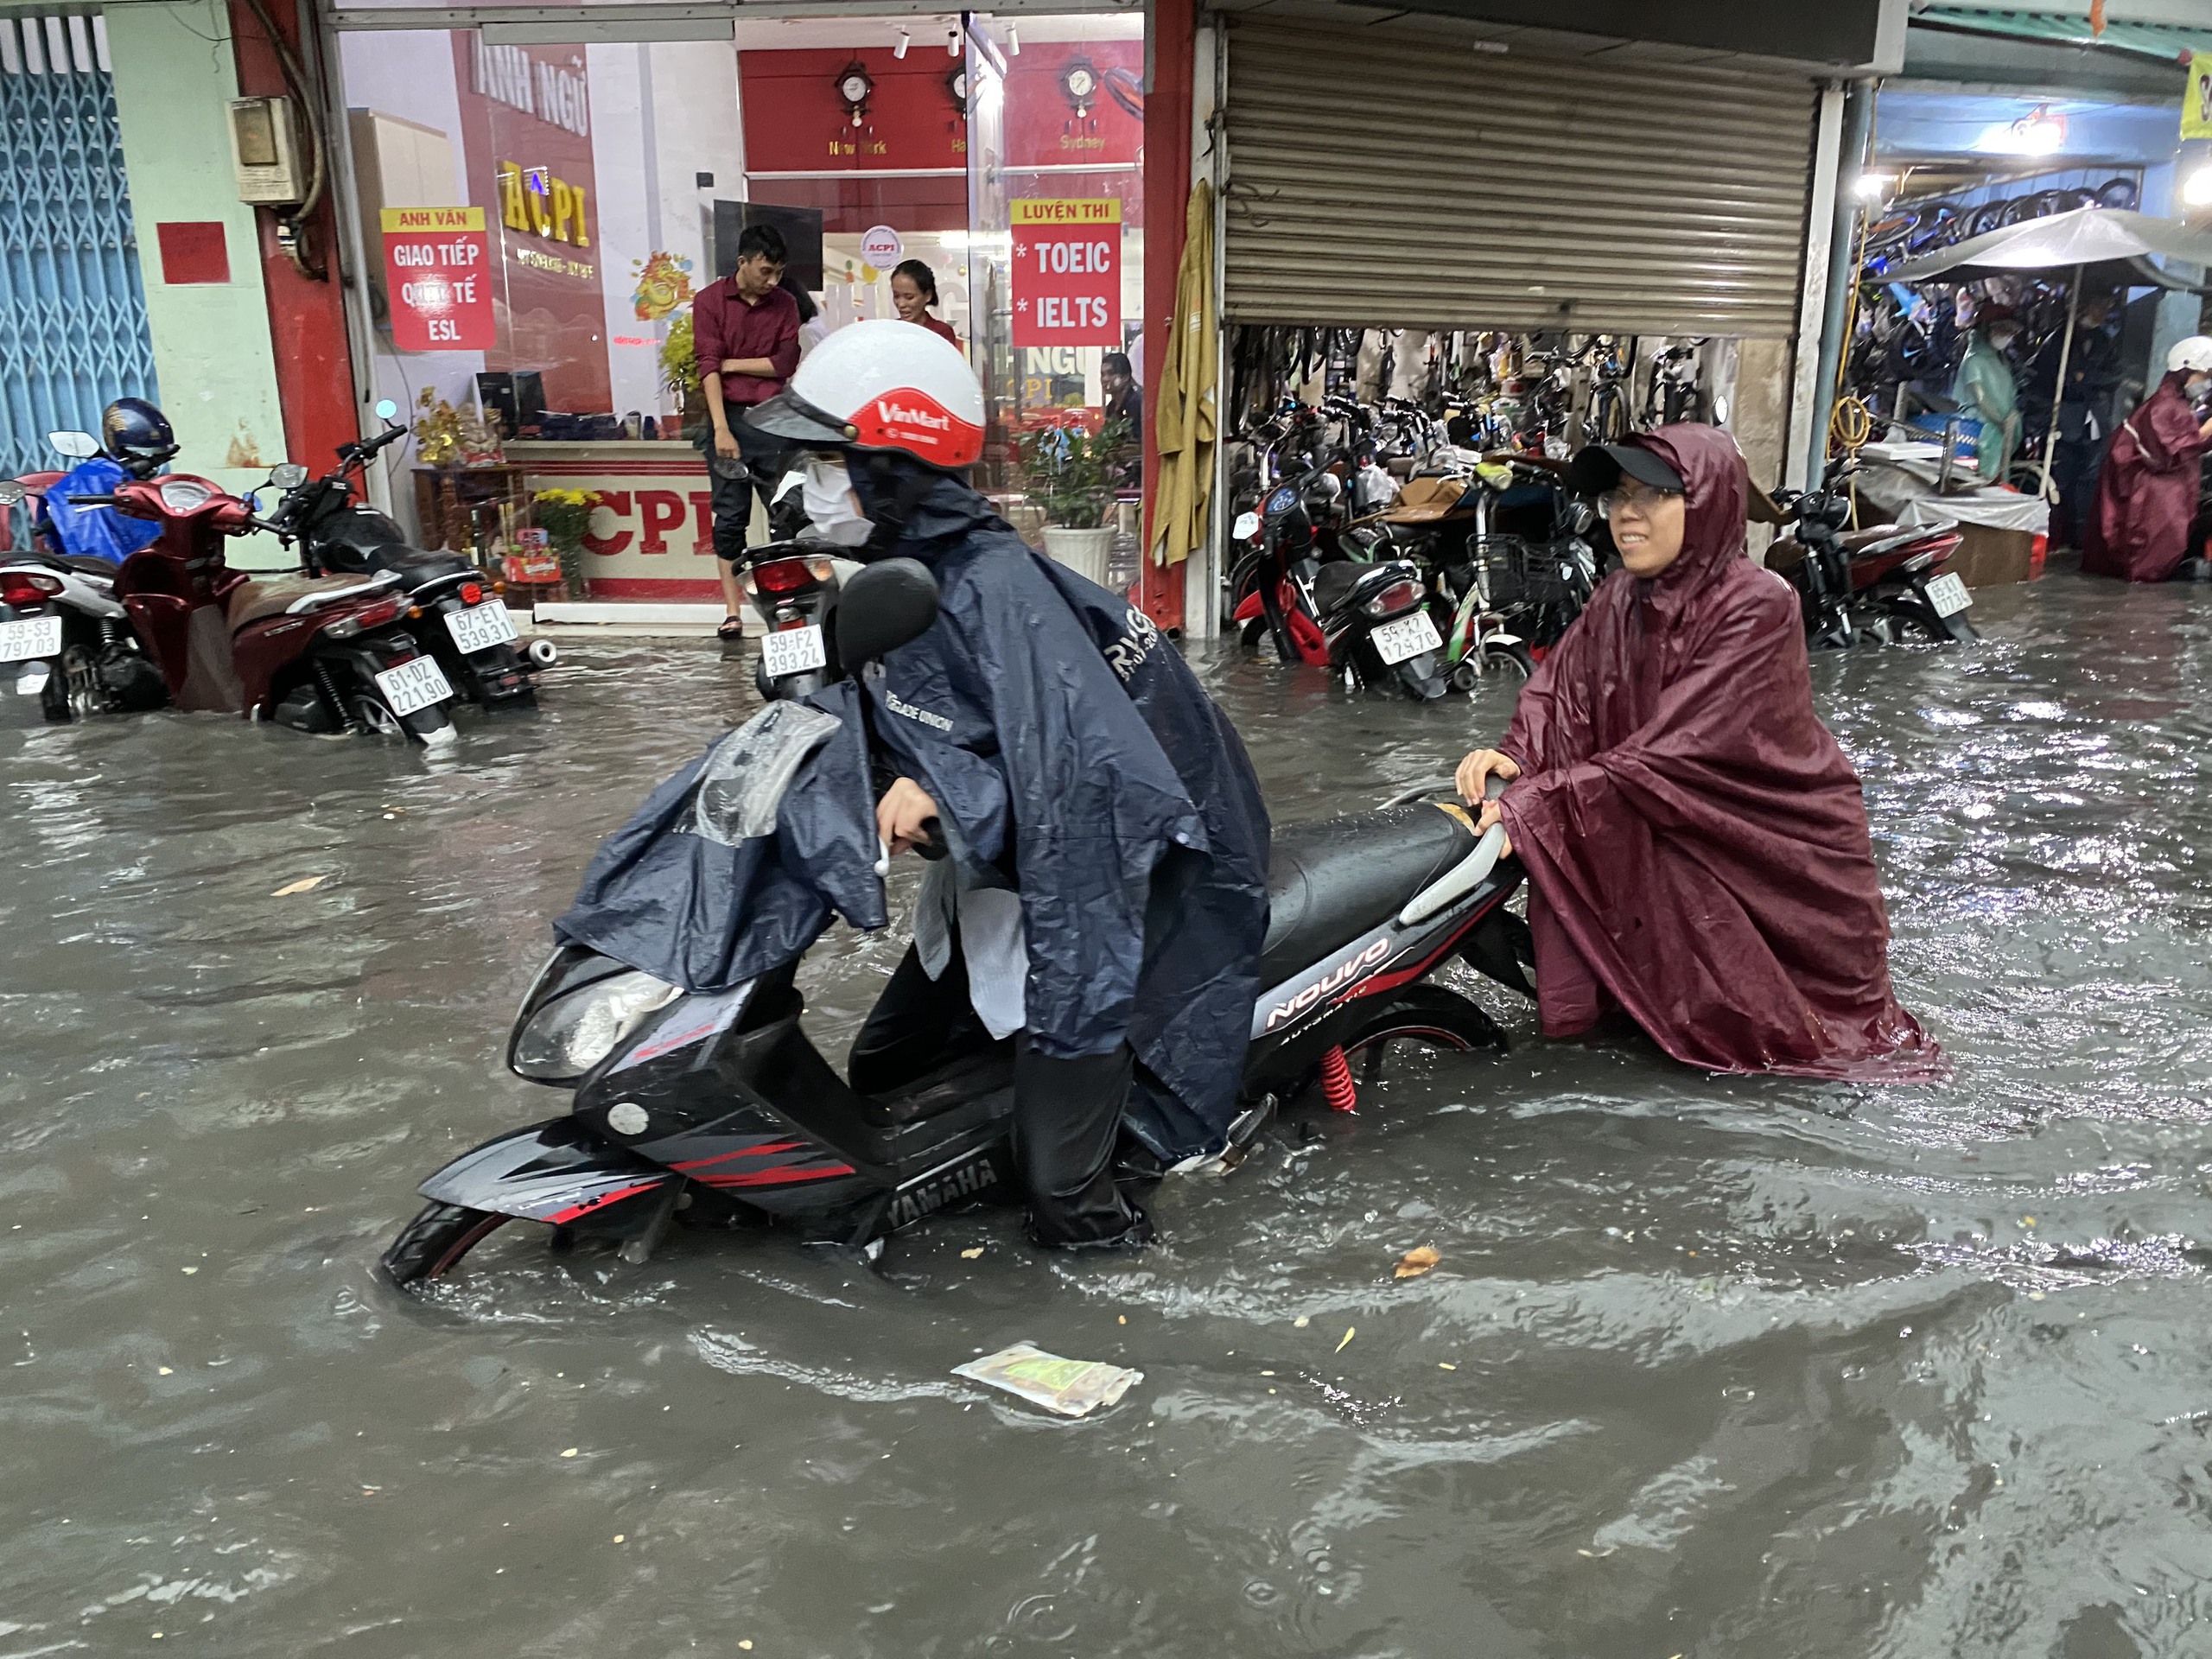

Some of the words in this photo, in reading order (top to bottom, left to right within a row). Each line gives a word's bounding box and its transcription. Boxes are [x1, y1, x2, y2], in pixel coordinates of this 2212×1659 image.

[1060, 134, 1106, 152] Sydney
[399, 213, 431, 226] ANH
[435, 209, 467, 226] VĂN
[500, 161, 590, 248] ACPI
[1023, 200, 1077, 223] LUYỆN
[1082, 203, 1109, 219] THI
[393, 244, 435, 267] GIAO
[437, 235, 480, 266] TIẾP
[868, 244, 895, 252] ACPI
[1034, 241, 1111, 274] TOEIC
[453, 273, 478, 303] TẾ
[1037, 296, 1109, 328] IELTS
[428, 319, 461, 341] ESL
[877, 400, 951, 432] VinMart
[8, 620, 52, 641] 59-S3
[455, 604, 499, 632] 67-E1
[3, 637, 55, 659] 797.03
[457, 621, 513, 650] 539.31
[769, 629, 814, 654] 59-F2
[768, 648, 821, 674] 393.24
[387, 662, 432, 691] 61-D2
[392, 678, 448, 713] 221.90
[1266, 938, 1392, 1029] NOUVO
[887, 1159, 998, 1228] YAMAHA
